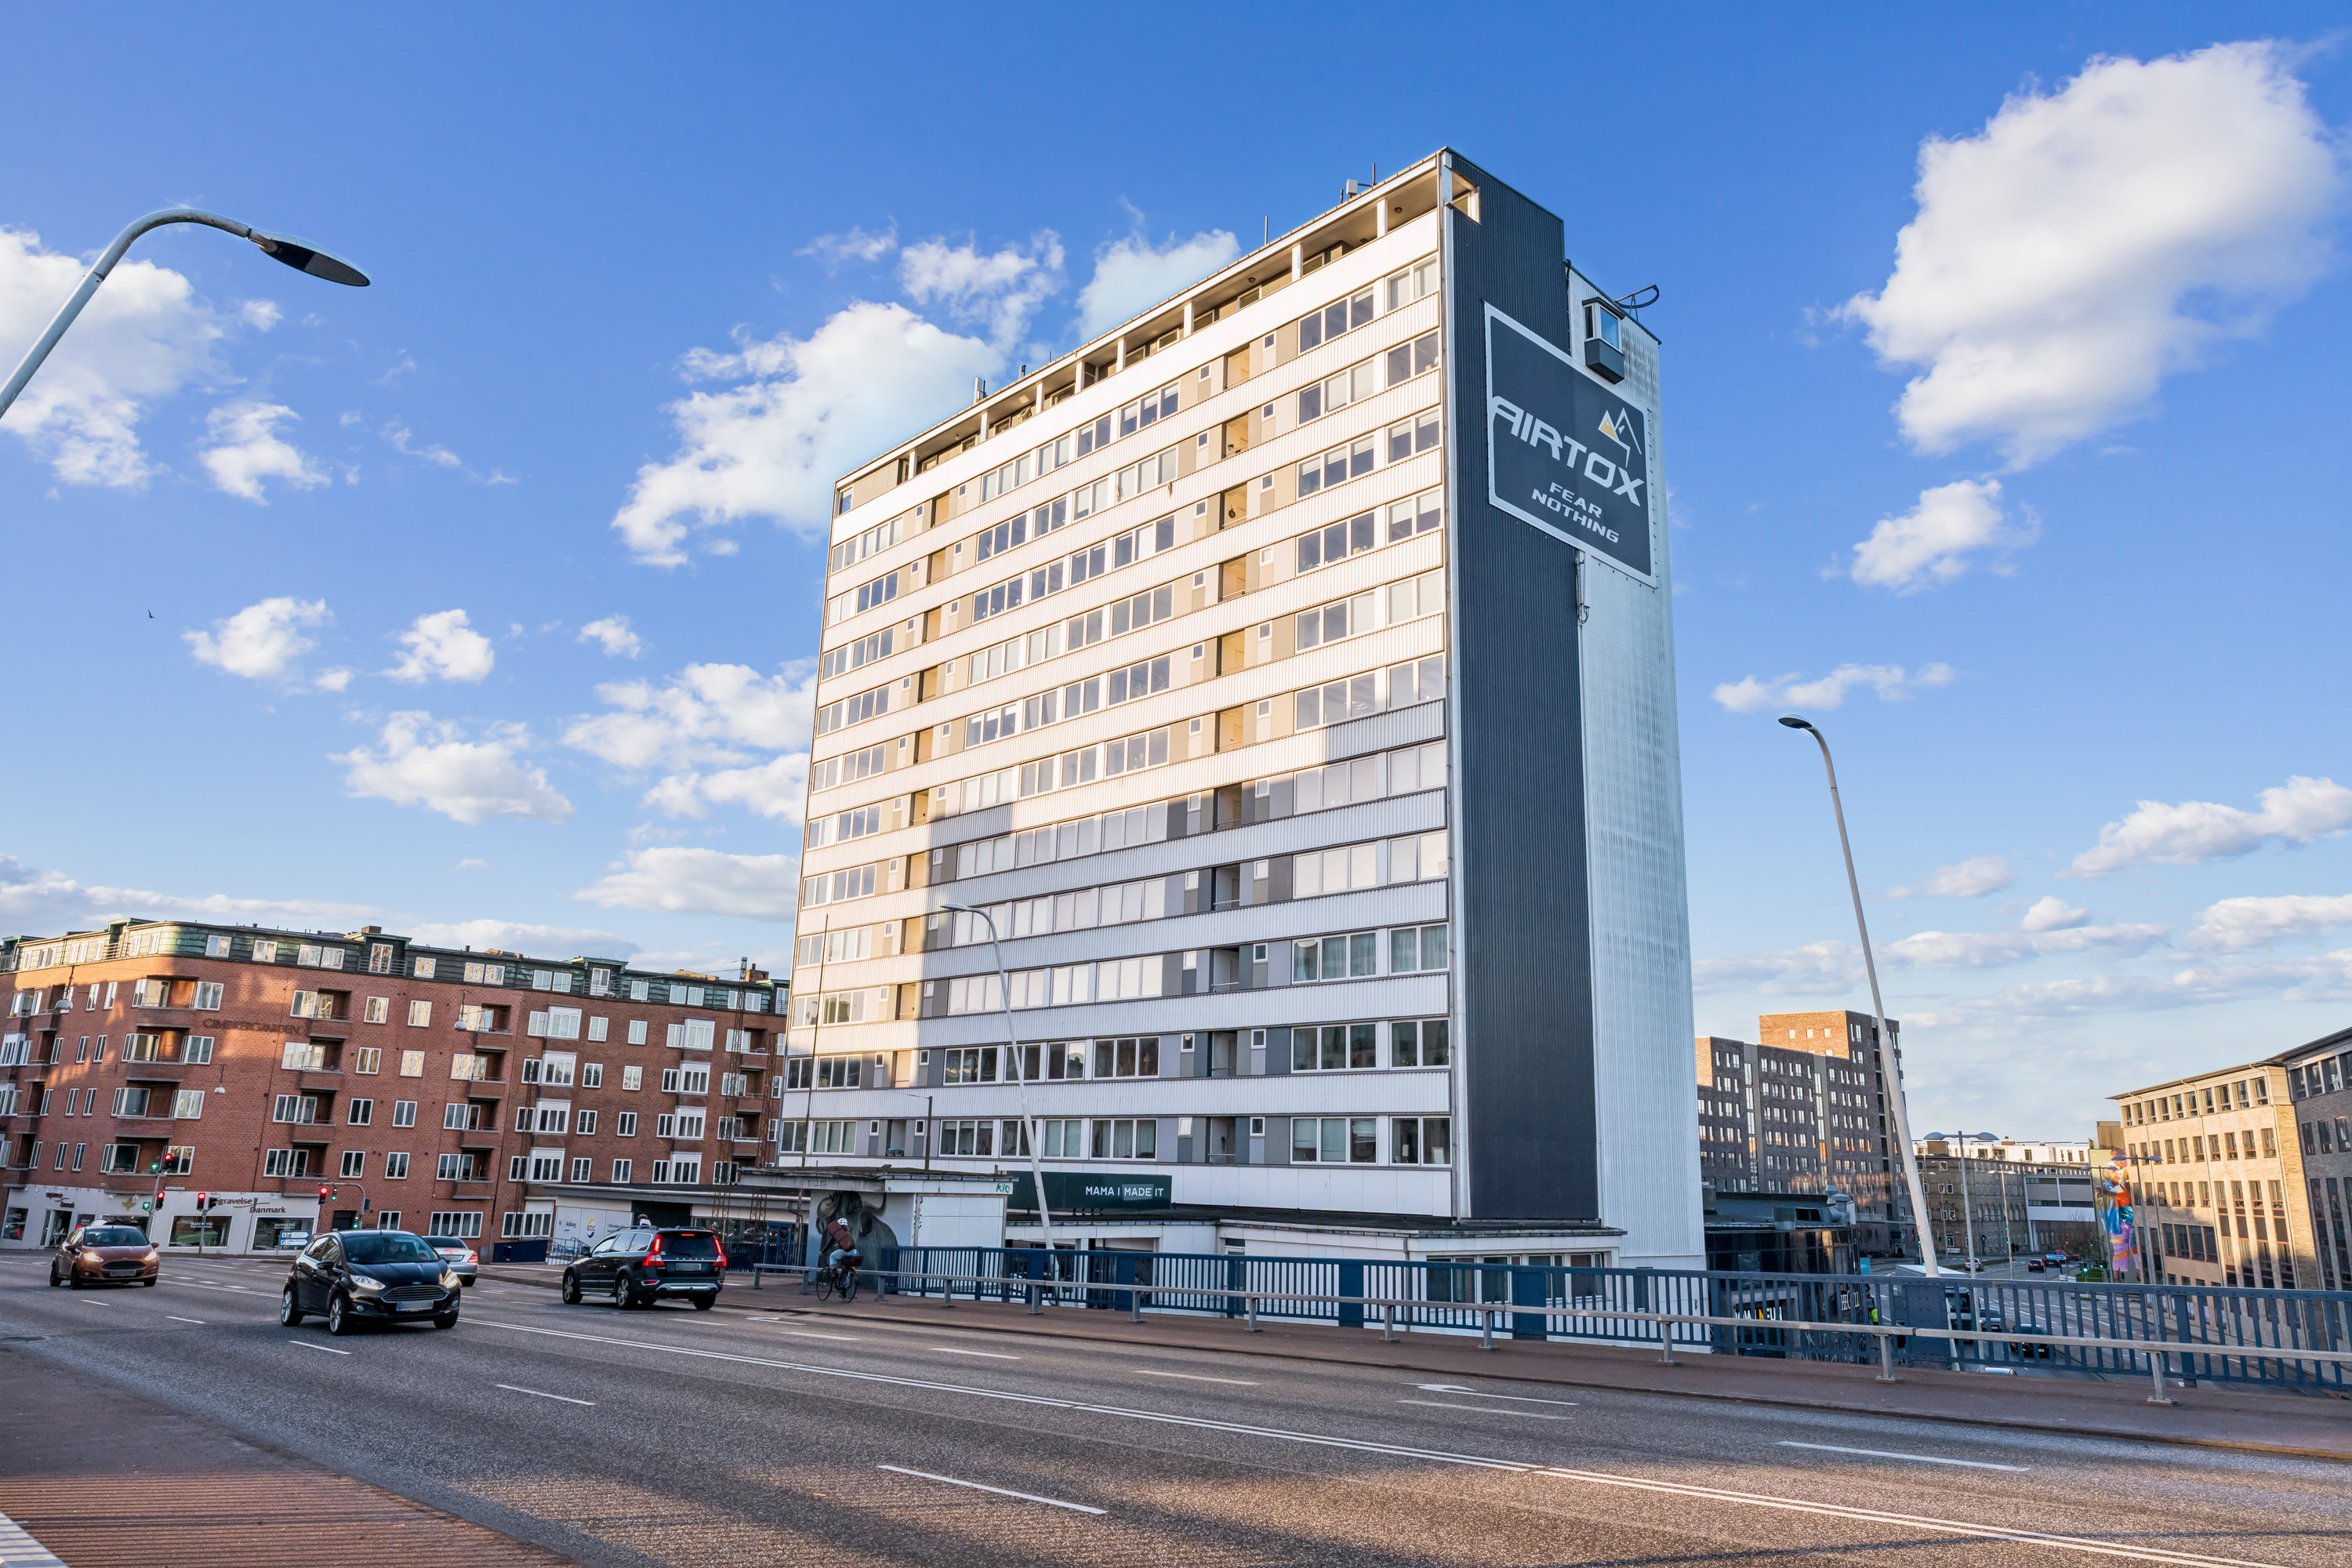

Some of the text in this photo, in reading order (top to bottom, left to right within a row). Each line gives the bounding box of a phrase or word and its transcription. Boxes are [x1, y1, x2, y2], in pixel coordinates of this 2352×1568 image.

[1491, 395, 1645, 507] AIRTOX
[1531, 488, 1619, 543] NOTHING
[1549, 481, 1602, 518] FEAR
[1085, 1186, 1164, 1196] MAMA I MADE IT
